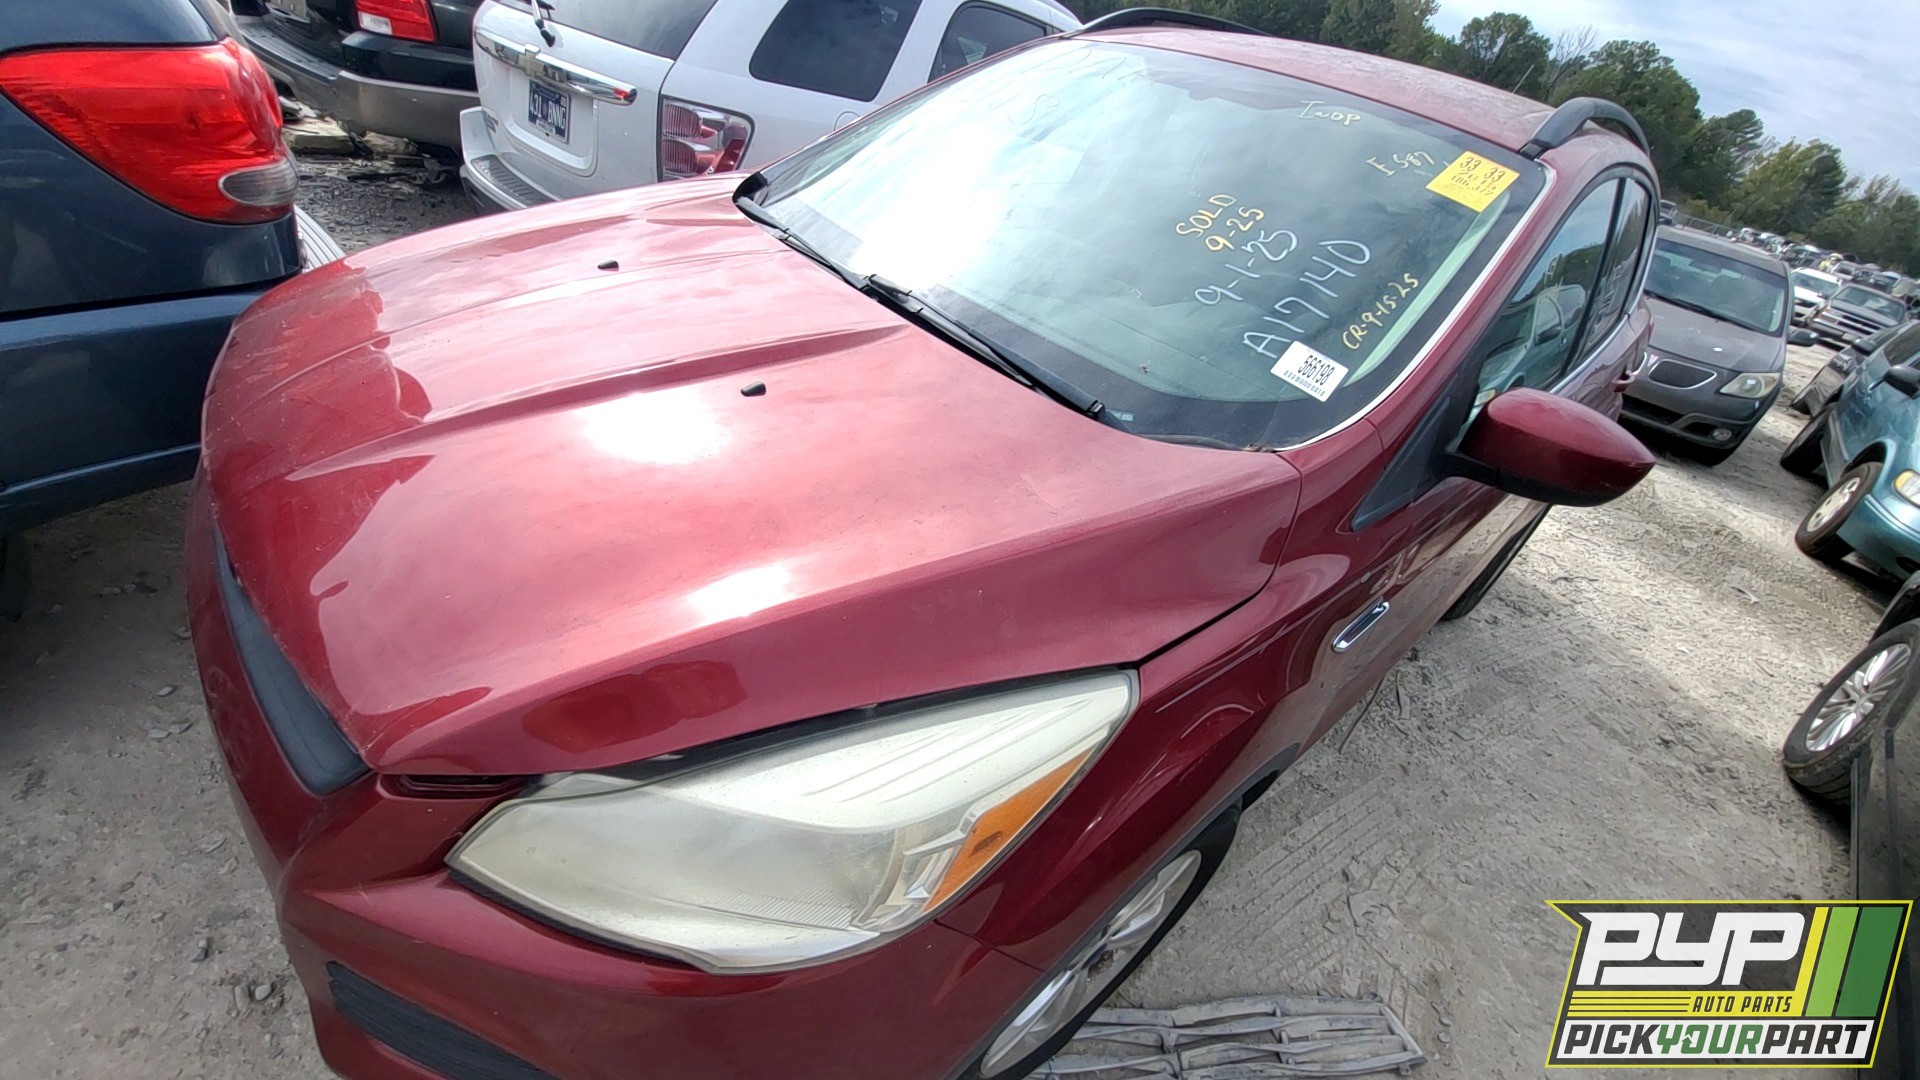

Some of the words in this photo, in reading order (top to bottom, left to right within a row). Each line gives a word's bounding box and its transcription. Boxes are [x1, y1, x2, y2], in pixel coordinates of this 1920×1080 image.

[1460, 156, 1481, 171] 33
[1483, 167, 1506, 182] 33
[1176, 194, 1237, 238] SOLD
[1205, 206, 1264, 251] 9-25
[1242, 239, 1371, 359] A17140
[1297, 354, 1336, 386] 566198
